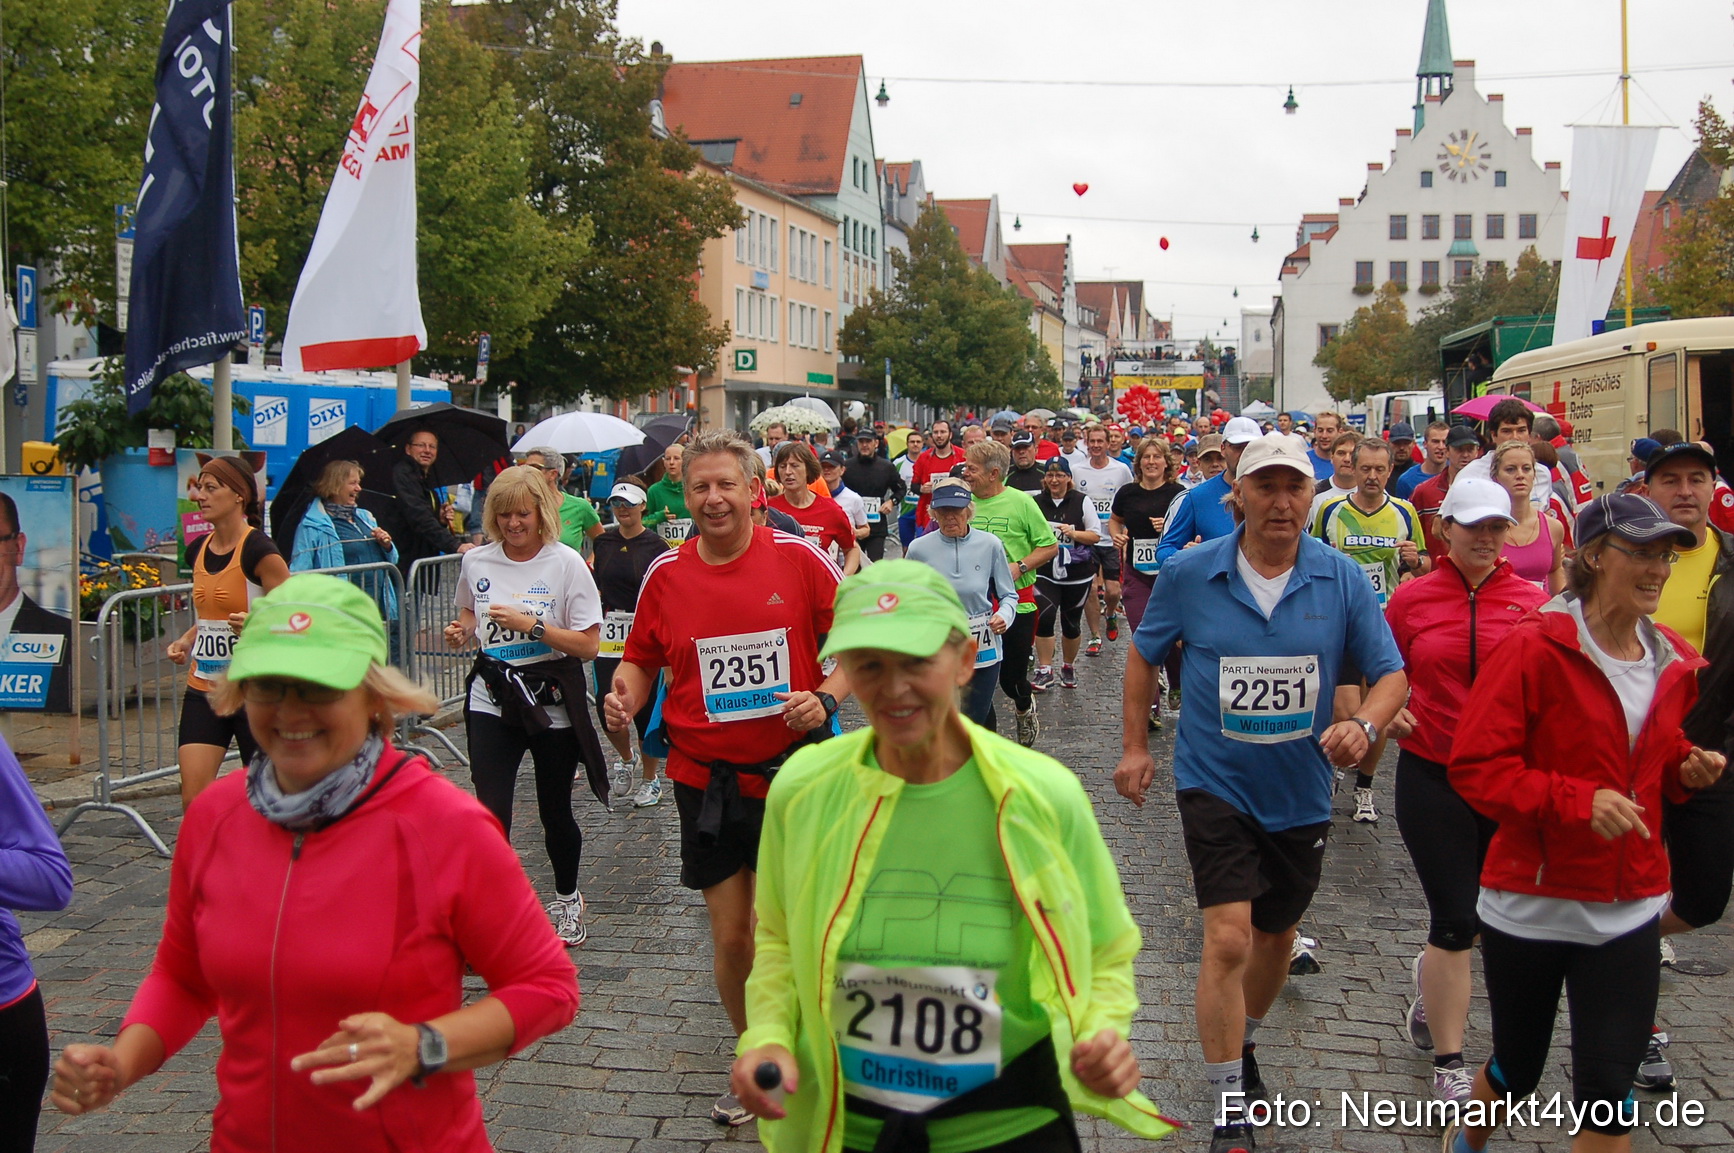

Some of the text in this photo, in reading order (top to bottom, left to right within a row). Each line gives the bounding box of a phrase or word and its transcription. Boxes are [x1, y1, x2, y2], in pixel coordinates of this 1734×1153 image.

[22, 275, 33, 321] P
[252, 311, 262, 339] P
[738, 351, 754, 368] D
[1142, 378, 1173, 387] START
[1571, 372, 1621, 399] Bayerisches
[255, 401, 288, 425] DIXI
[309, 403, 346, 426] DIXI
[1570, 401, 1594, 420] Rotes
[664, 526, 685, 539] 501
[1345, 535, 1397, 547] BOCK
[1137, 548, 1156, 562] 20
[971, 628, 992, 647] 74
[12, 643, 41, 653] CSU
[500, 646, 535, 659] Claudia
[700, 640, 773, 656] PARTL Neumarkt
[709, 651, 780, 690] 2351
[1222, 666, 1302, 674] PARTL Neumarkt
[0, 674, 43, 693] KER
[715, 692, 778, 710] Klaus-Pete
[1231, 678, 1306, 711] 2251
[1240, 719, 1298, 734] Wolfgang
[886, 976, 967, 998] Neumarkt
[846, 990, 983, 1055] 2108
[861, 1058, 959, 1093] Christine
